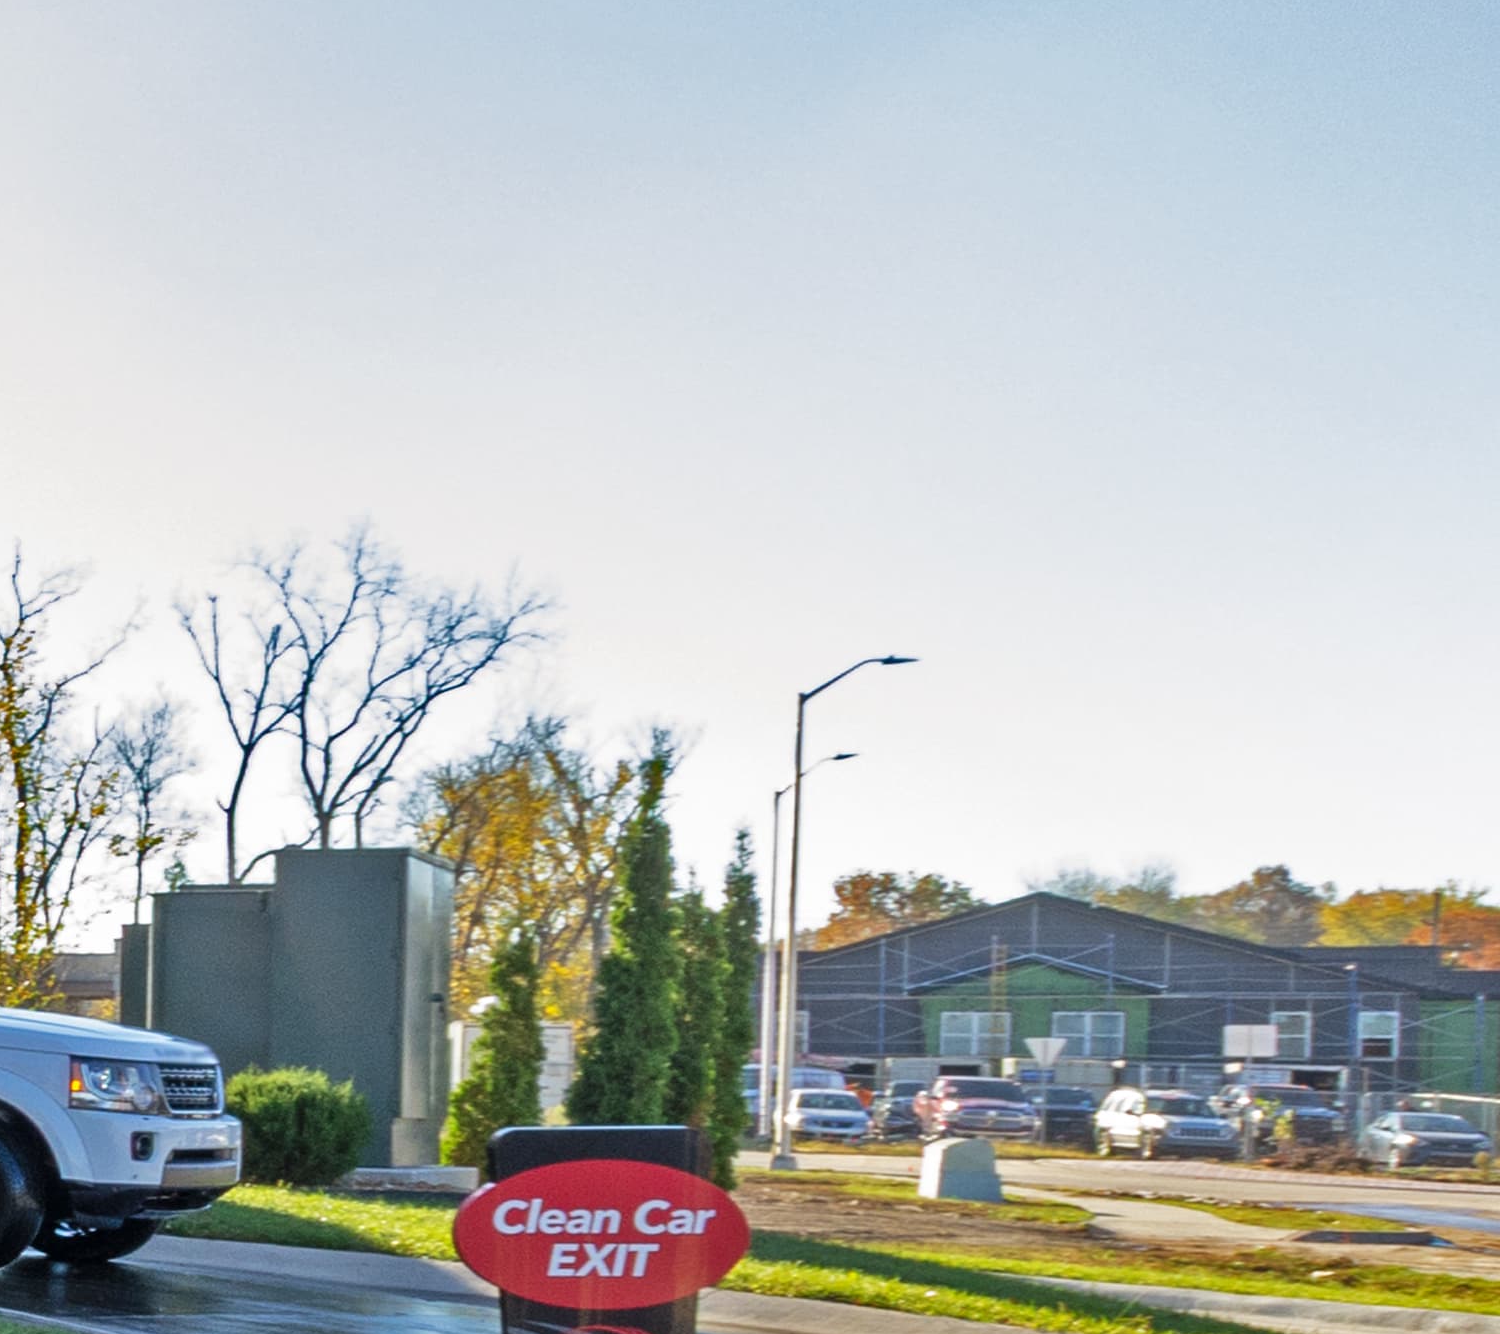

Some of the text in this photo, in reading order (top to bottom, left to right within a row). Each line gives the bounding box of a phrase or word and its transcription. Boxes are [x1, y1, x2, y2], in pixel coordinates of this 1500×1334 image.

[492, 1198, 717, 1235] Clean Car
[546, 1243, 661, 1277] EXIT
